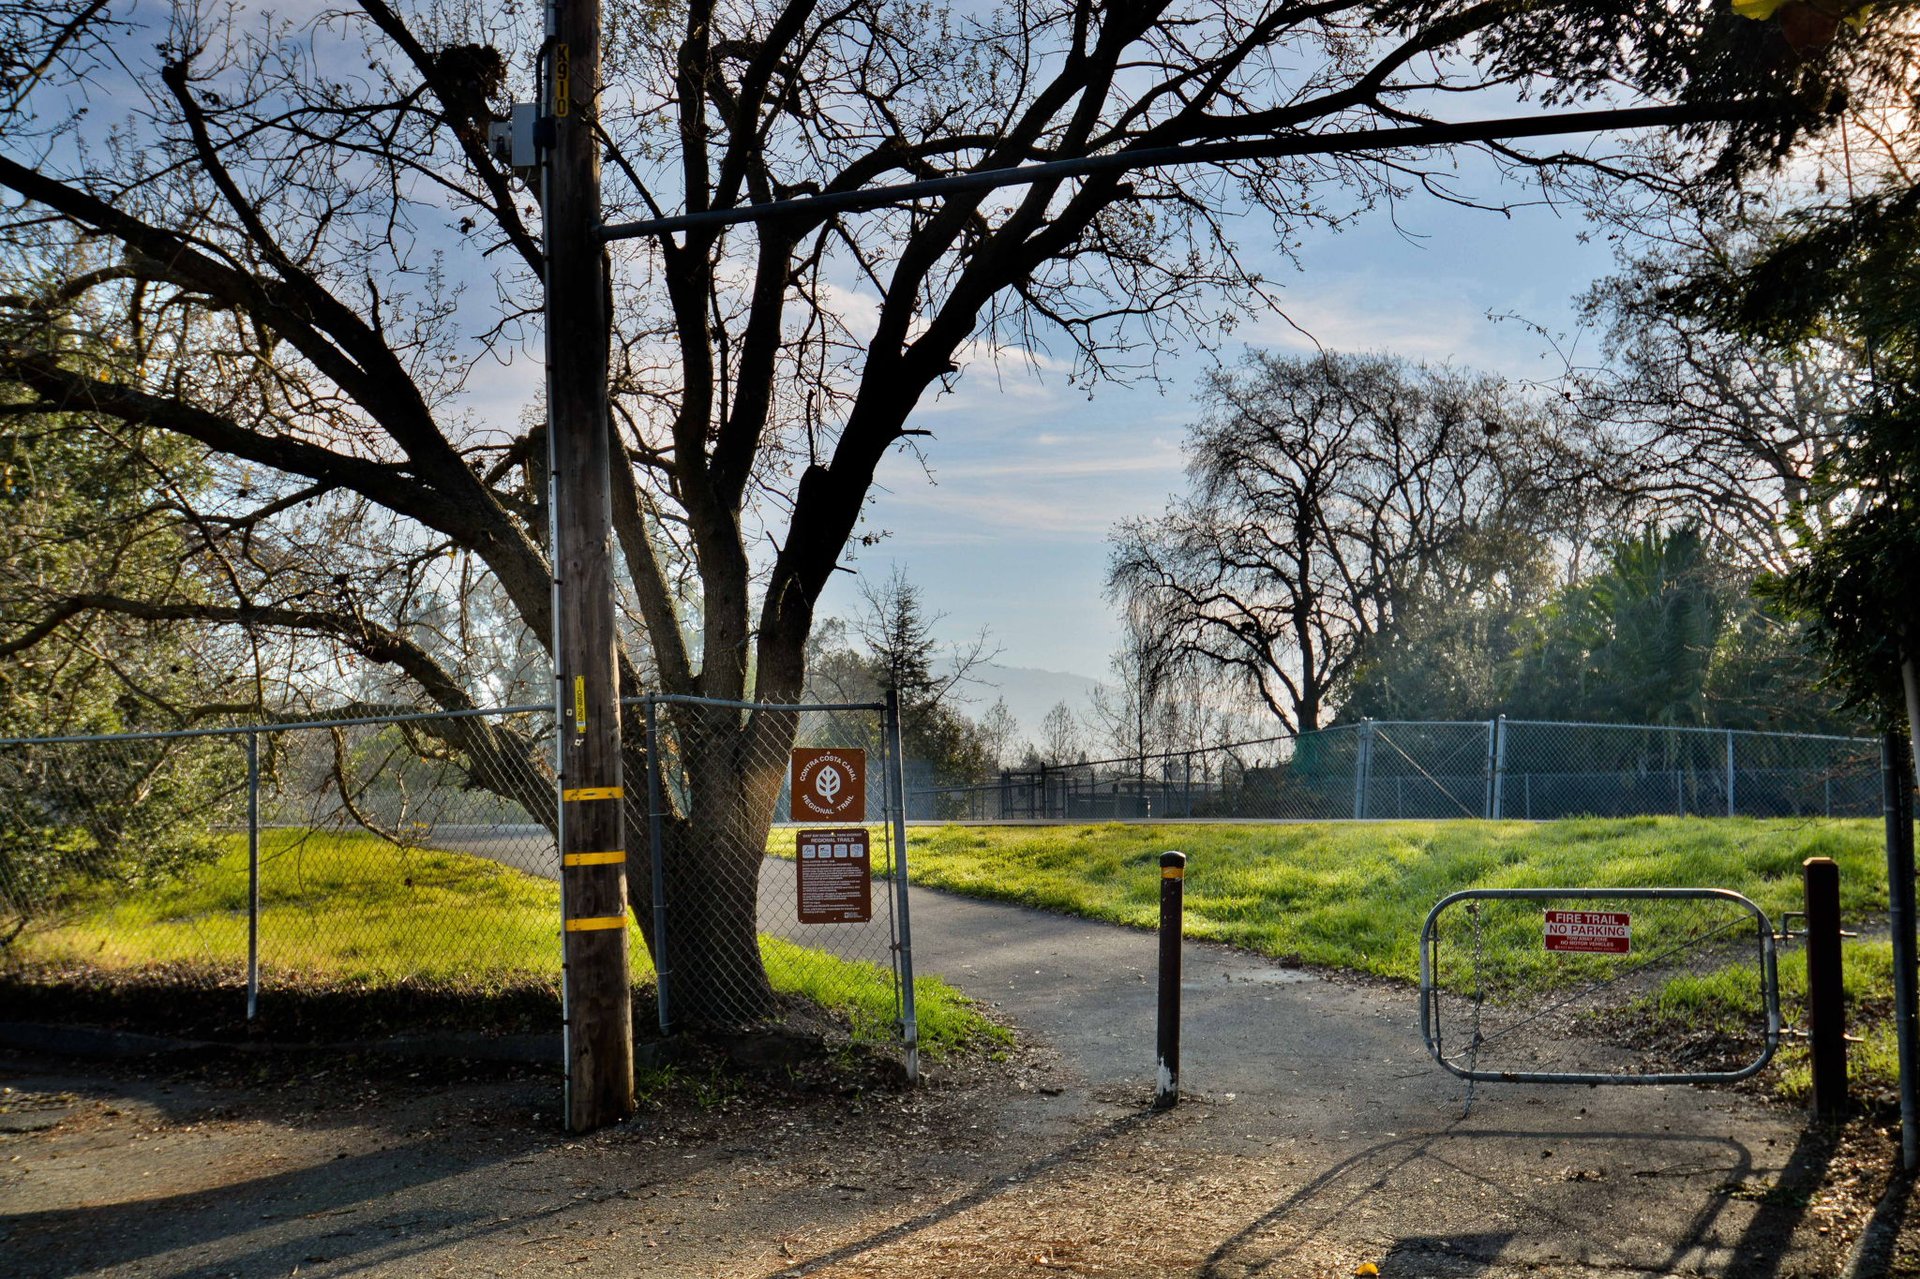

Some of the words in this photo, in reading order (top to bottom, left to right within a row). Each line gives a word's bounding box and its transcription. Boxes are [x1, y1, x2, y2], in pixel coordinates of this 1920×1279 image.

[799, 758, 820, 782] CONTRA
[819, 755, 842, 764] COSTA
[841, 761, 857, 783] CANAL
[802, 794, 834, 815] REGIONAL
[836, 795, 854, 812] TRAIL
[1556, 913, 1582, 923] FIRE
[1585, 914, 1619, 925] TRAIL
[1549, 924, 1567, 934] NO
[1571, 925, 1625, 936] PARKING
